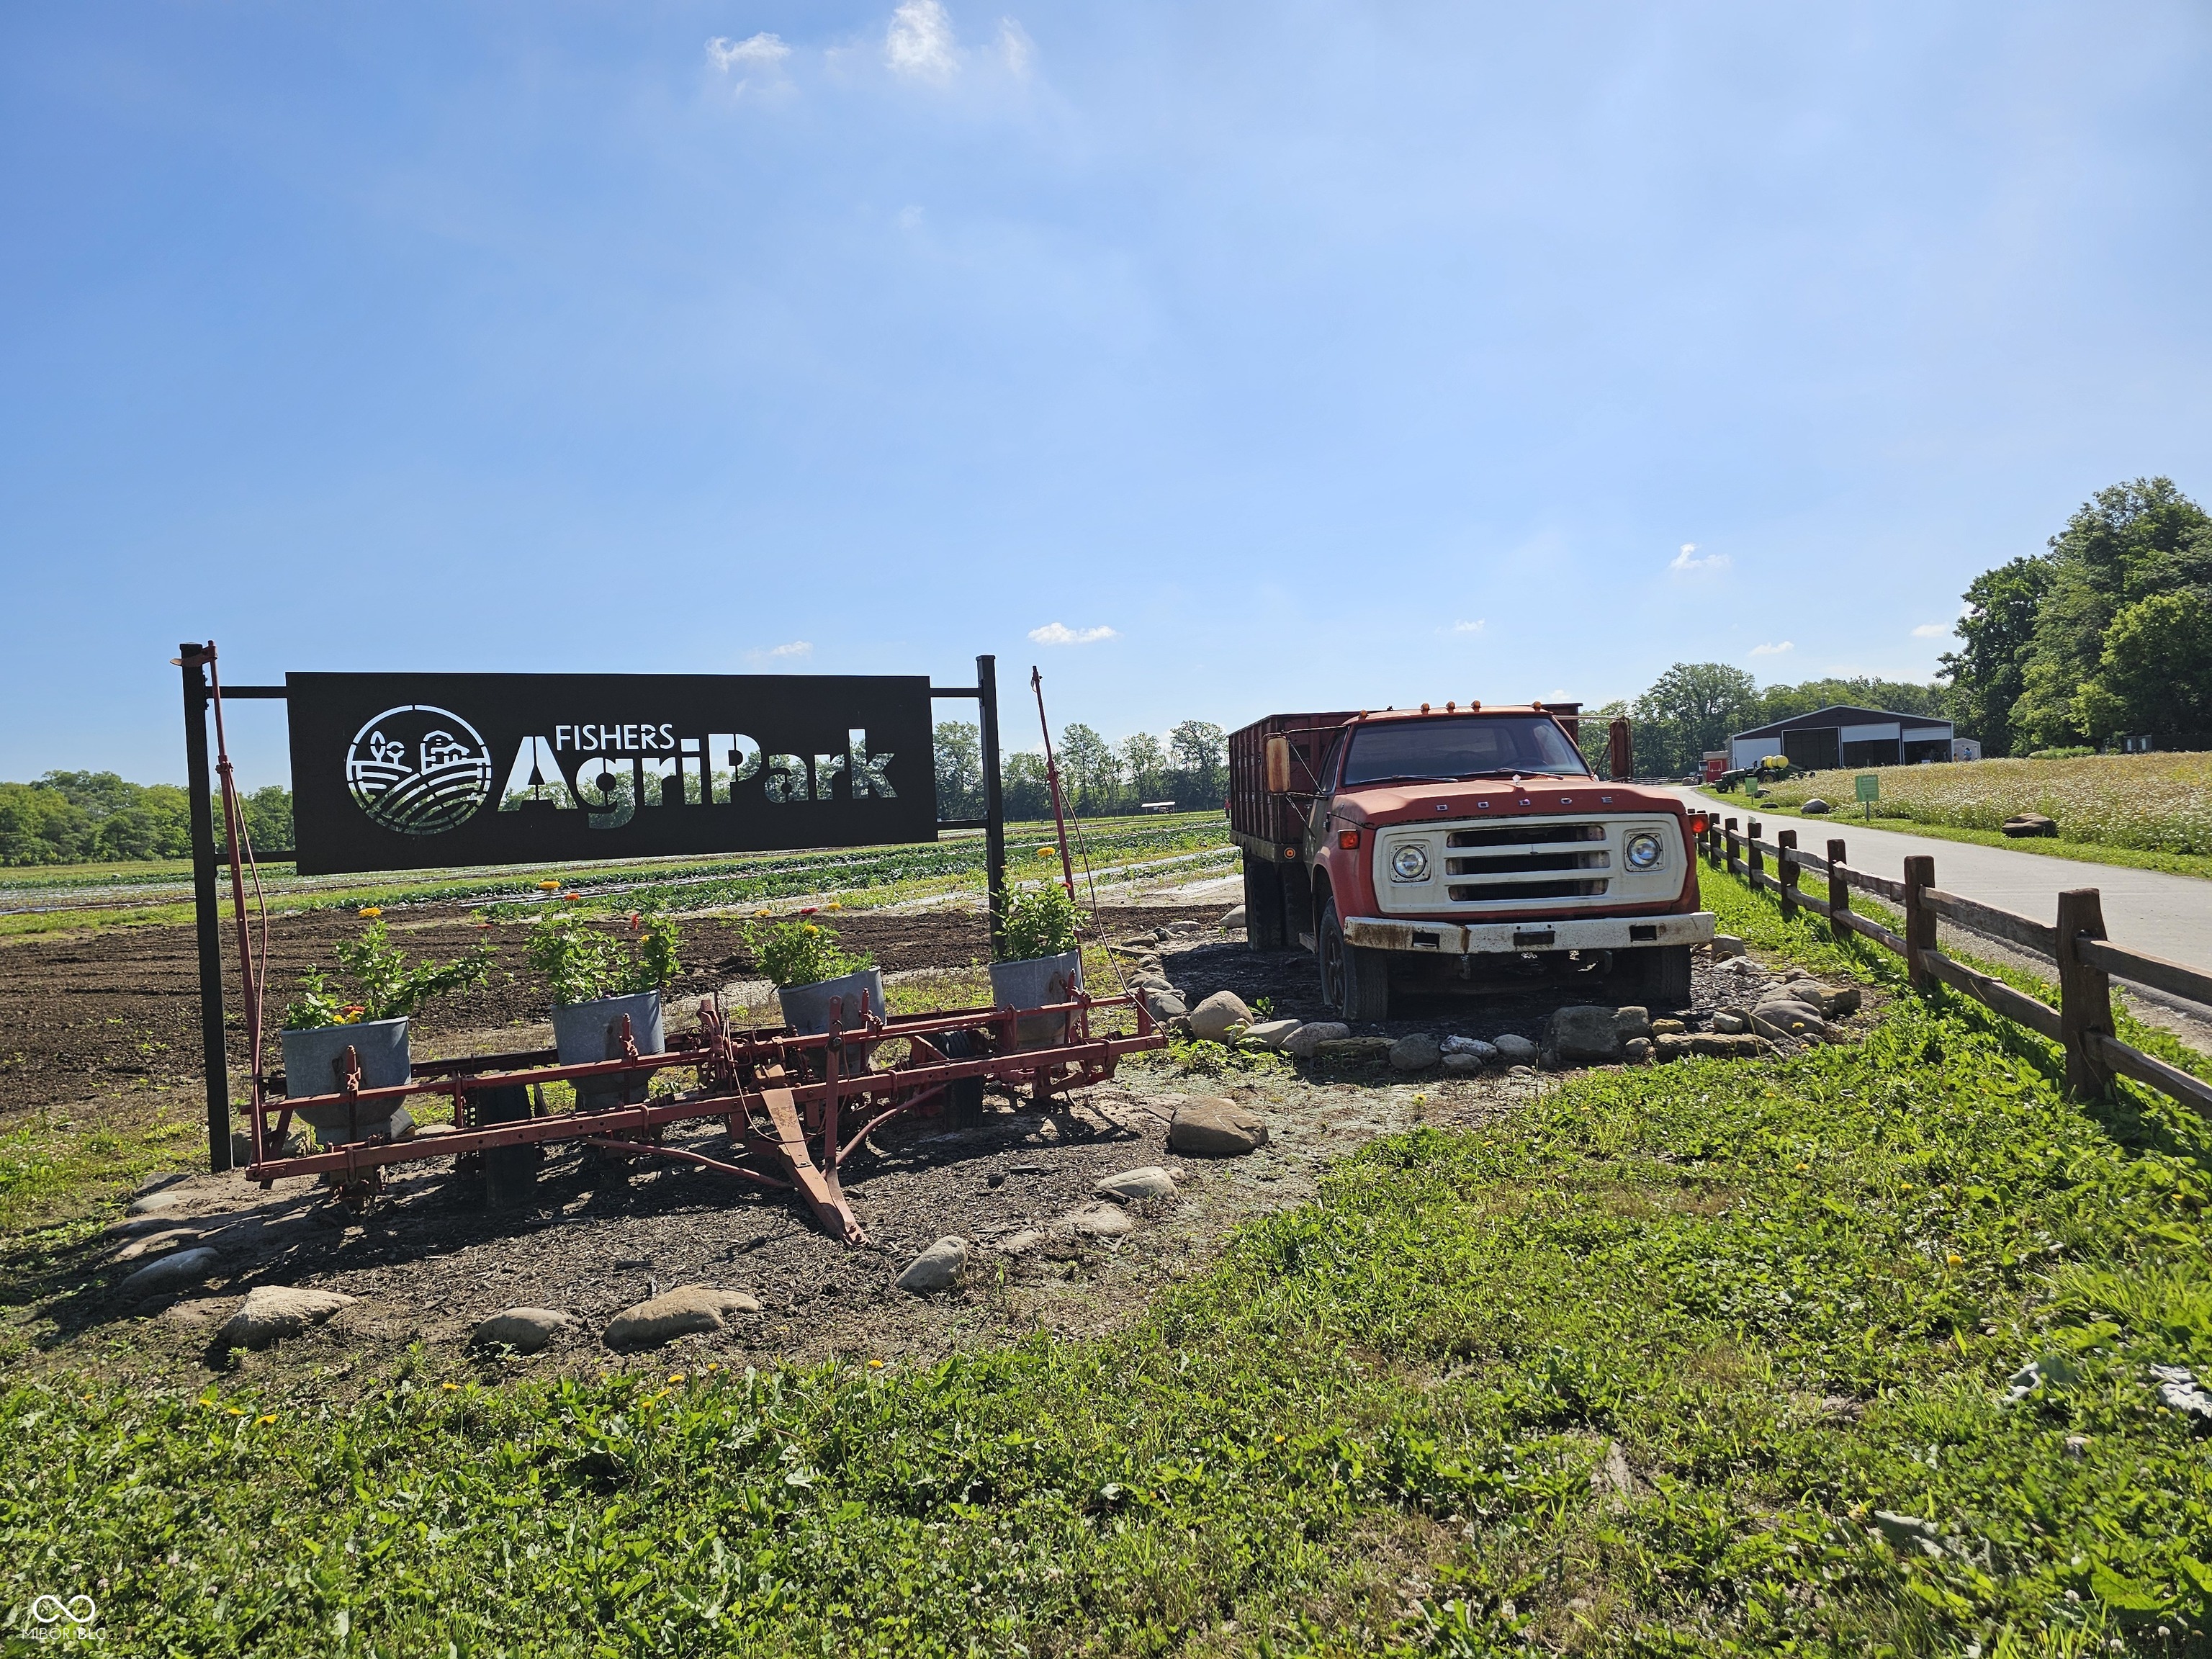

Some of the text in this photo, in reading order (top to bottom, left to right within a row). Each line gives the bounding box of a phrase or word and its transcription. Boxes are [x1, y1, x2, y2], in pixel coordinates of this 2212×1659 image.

[555, 724, 675, 751] FISHERS
[497, 729, 898, 830] AgriPark
[1436, 796, 1613, 811] DODGE
